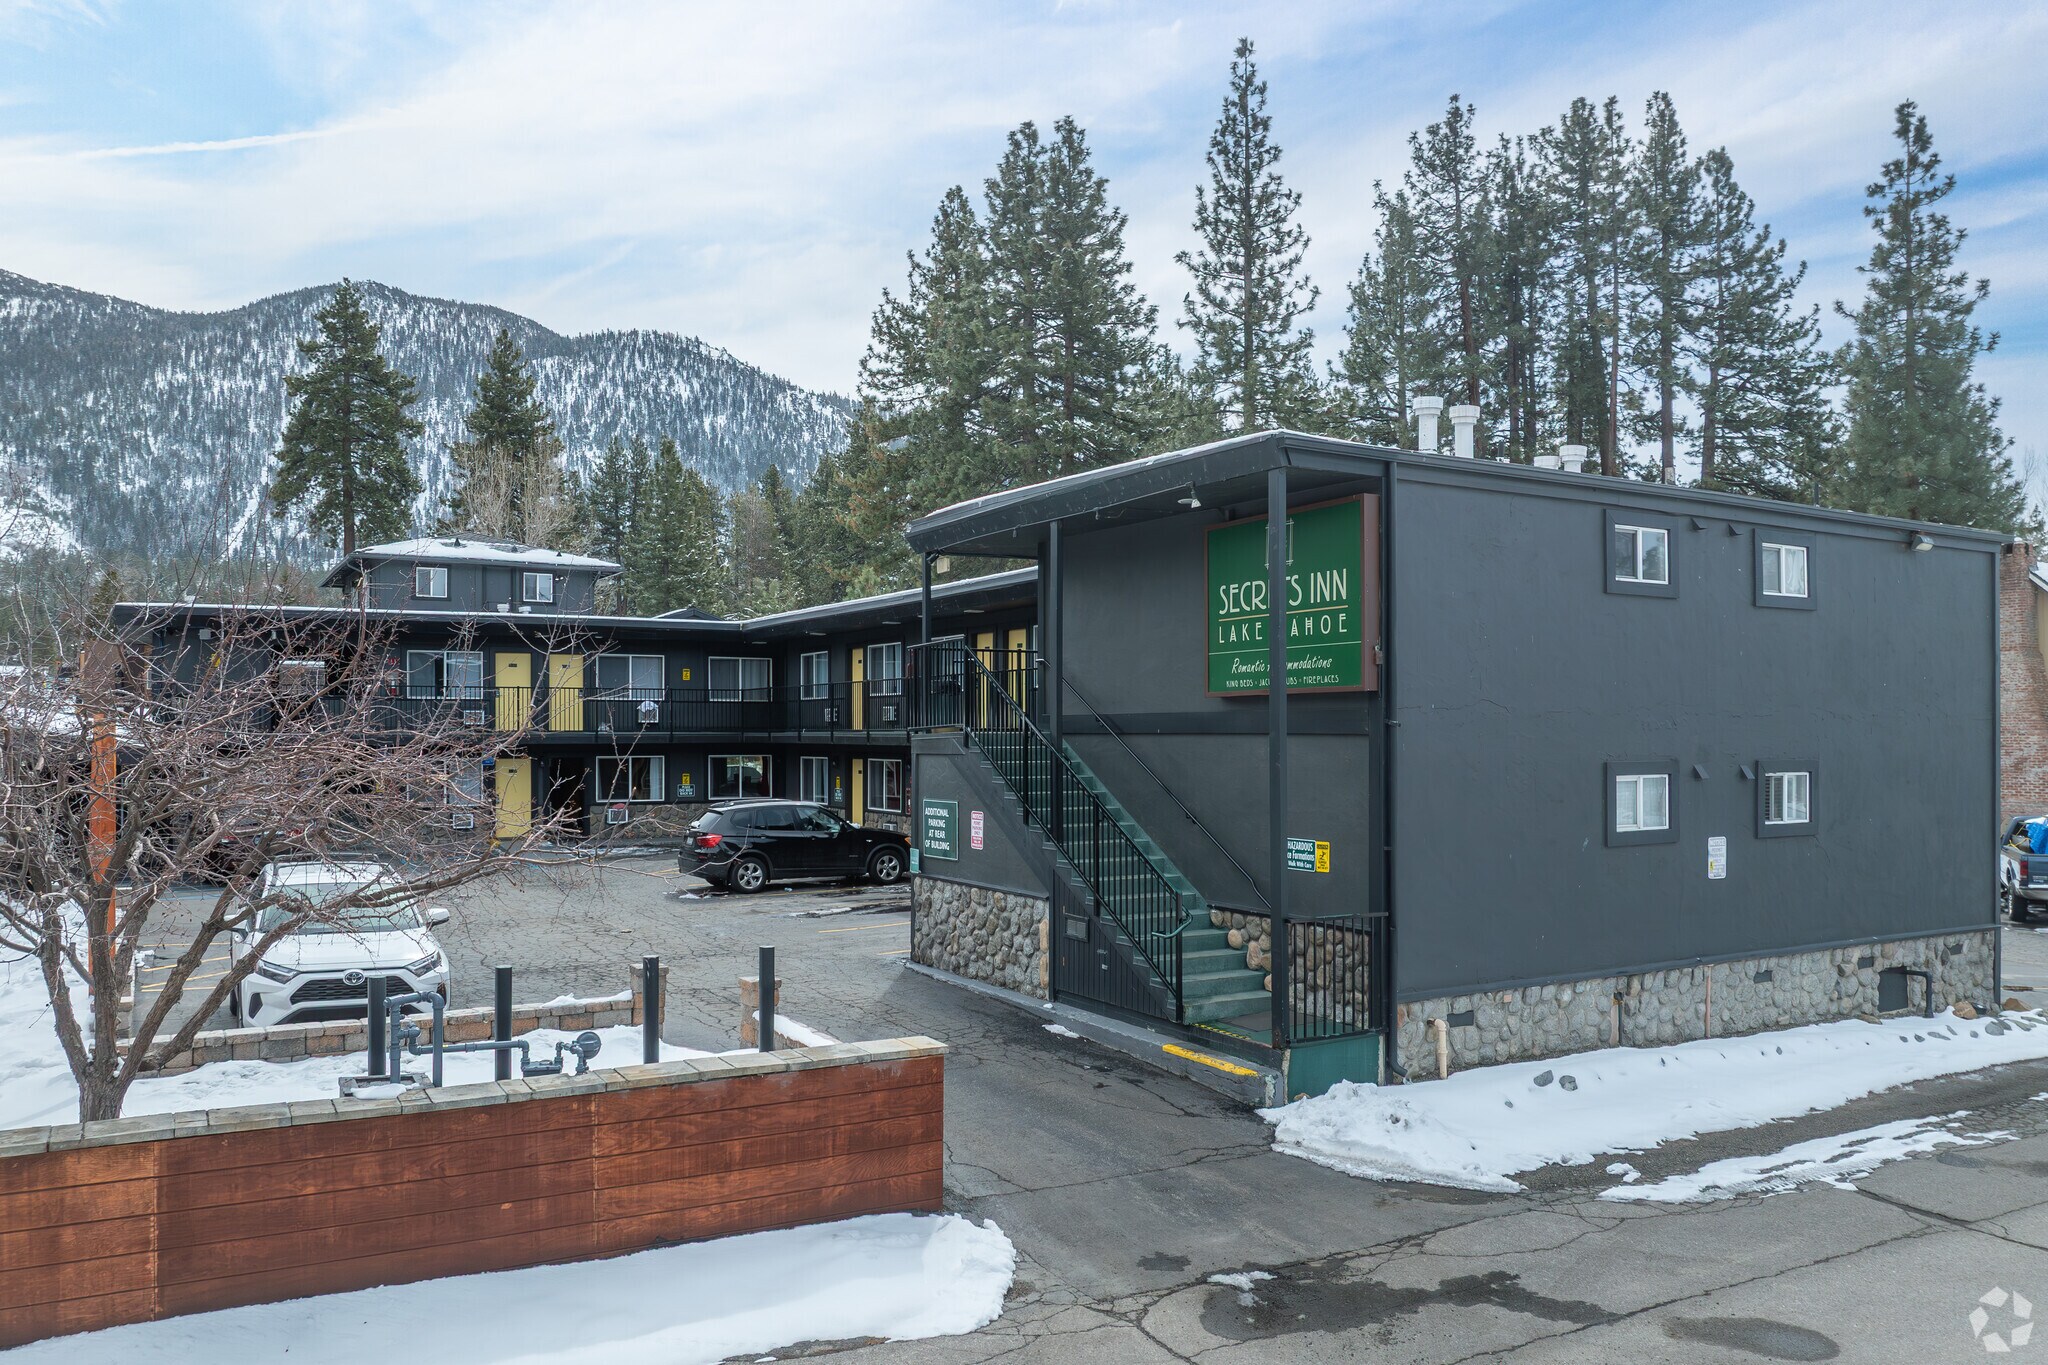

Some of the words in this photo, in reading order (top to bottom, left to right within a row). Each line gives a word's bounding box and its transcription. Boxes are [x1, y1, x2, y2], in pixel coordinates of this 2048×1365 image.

[1219, 575, 1303, 615] SECRS
[1310, 568, 1347, 604] INN
[1219, 622, 1263, 643] LAKE
[1290, 613, 1348, 637] AHOE
[1231, 657, 1266, 674] Romantic
[1226, 680, 1239, 688] KING
[1240, 679, 1254, 688] BEDS
[1285, 676, 1298, 685] UBS
[1303, 674, 1340, 684] FIREPLACES
[925, 807, 950, 817] ADDITIONAL
[928, 818, 946, 828] PARKING
[928, 829, 934, 838] AT
[934, 829, 946, 839] REAR
[925, 839, 930, 848] OF
[931, 840, 950, 851] BUILDING
[1288, 841, 1313, 851] HAZARDOUS
[1292, 850, 1315, 861] Formations
